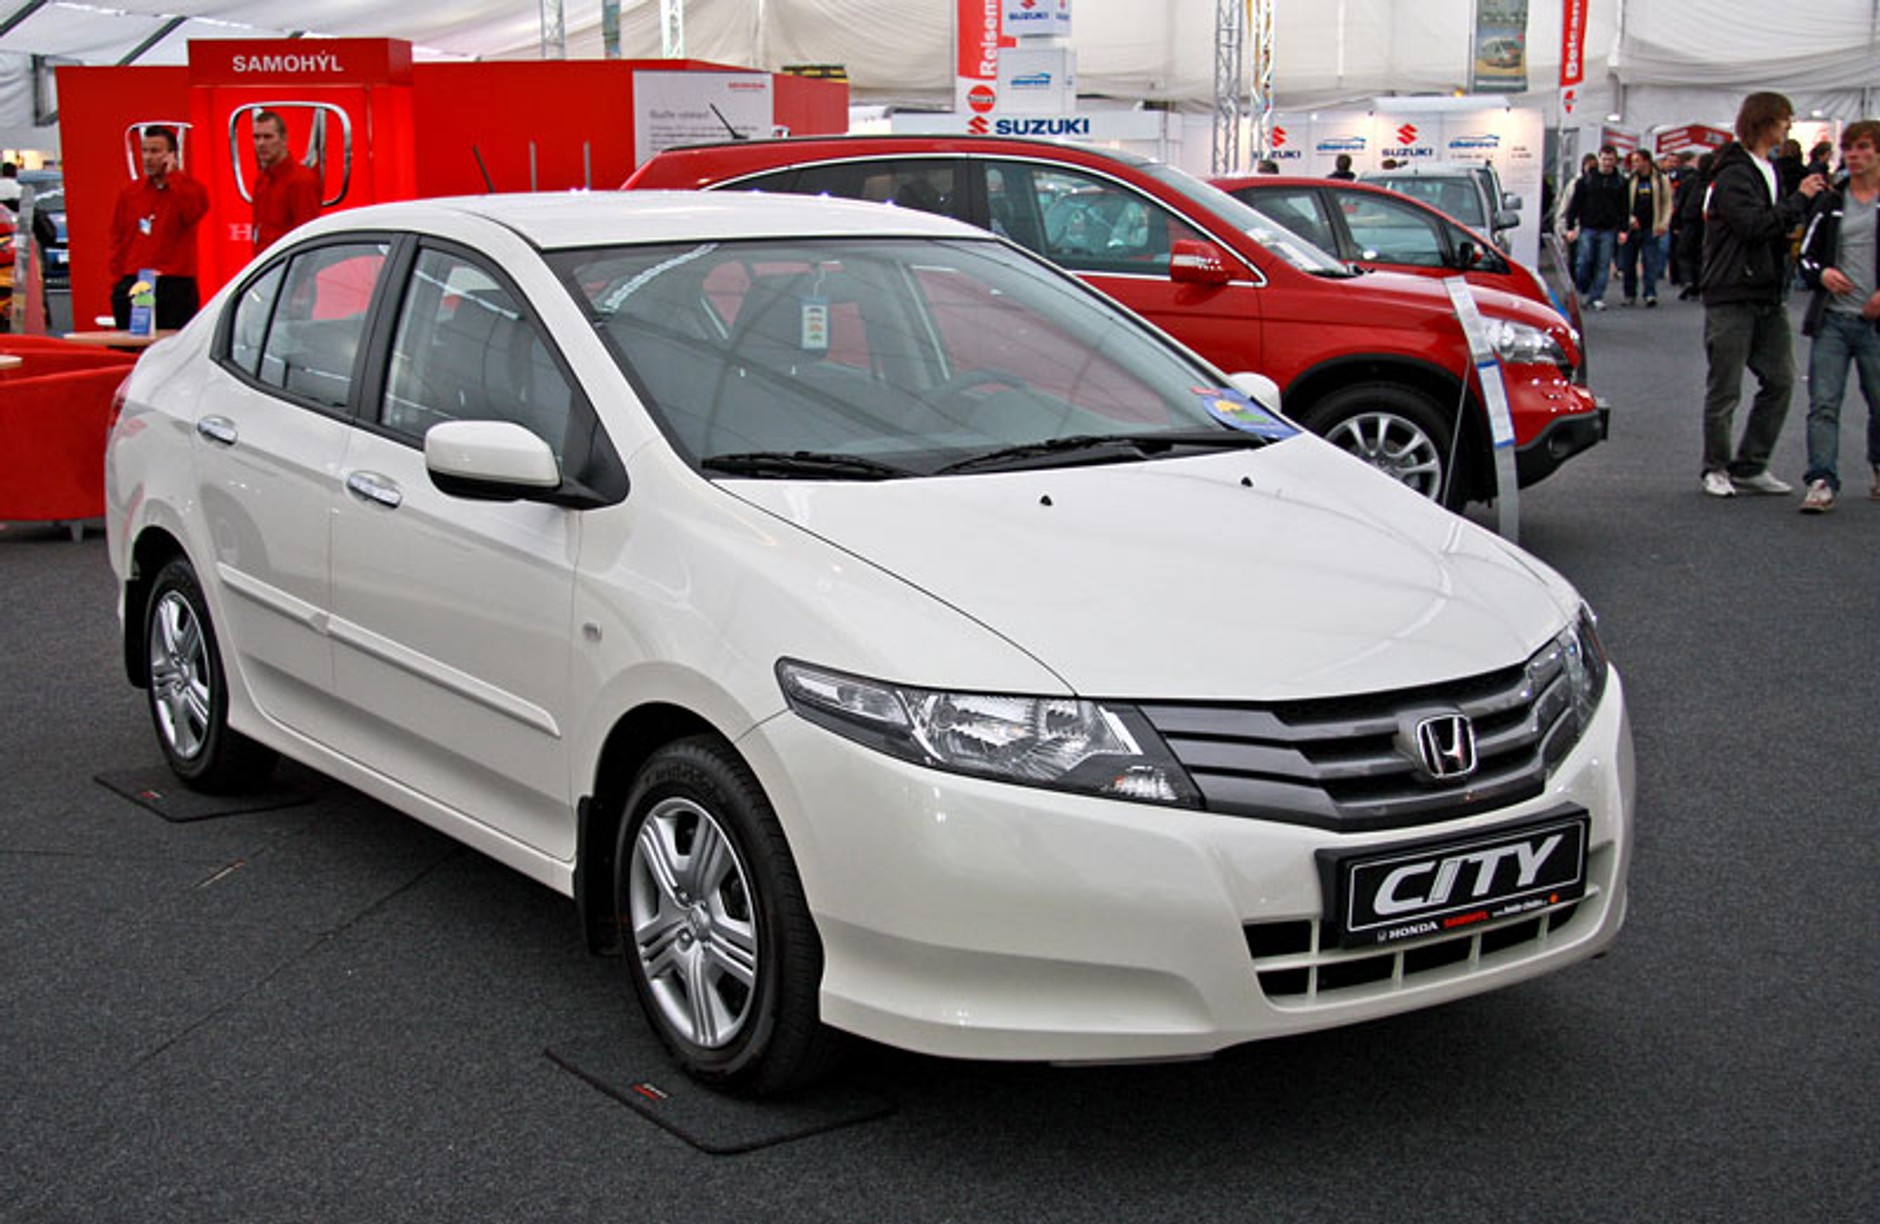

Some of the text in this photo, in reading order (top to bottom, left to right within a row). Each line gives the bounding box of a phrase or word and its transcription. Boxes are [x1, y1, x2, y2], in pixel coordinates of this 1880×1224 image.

[232, 50, 344, 73] SAMOHÝL
[995, 118, 1090, 135] SUZUKI
[1381, 148, 1433, 157] SUZUKI
[1372, 834, 1563, 916] CITY
[1389, 921, 1439, 939] HONDA
